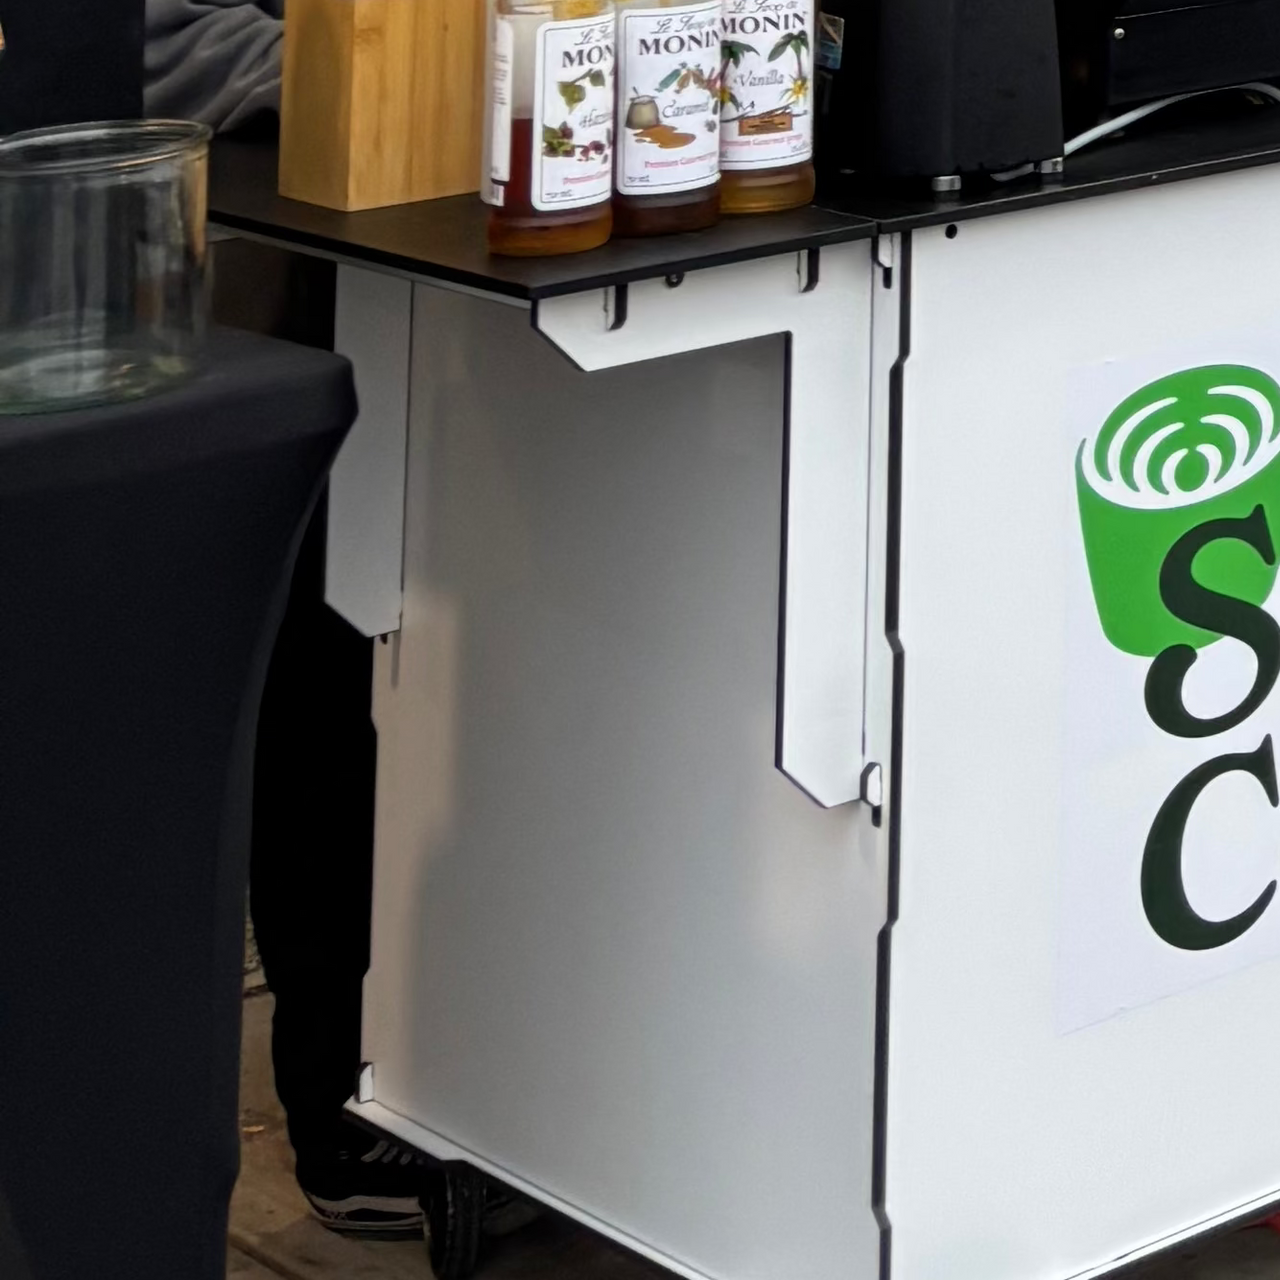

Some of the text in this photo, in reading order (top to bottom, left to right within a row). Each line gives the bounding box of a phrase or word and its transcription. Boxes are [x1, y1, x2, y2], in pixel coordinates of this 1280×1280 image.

[721, 12, 806, 35] MONIN
[562, 41, 615, 68] MON
[736, 69, 784, 88] Vanilla
[662, 99, 710, 118] Caramel
